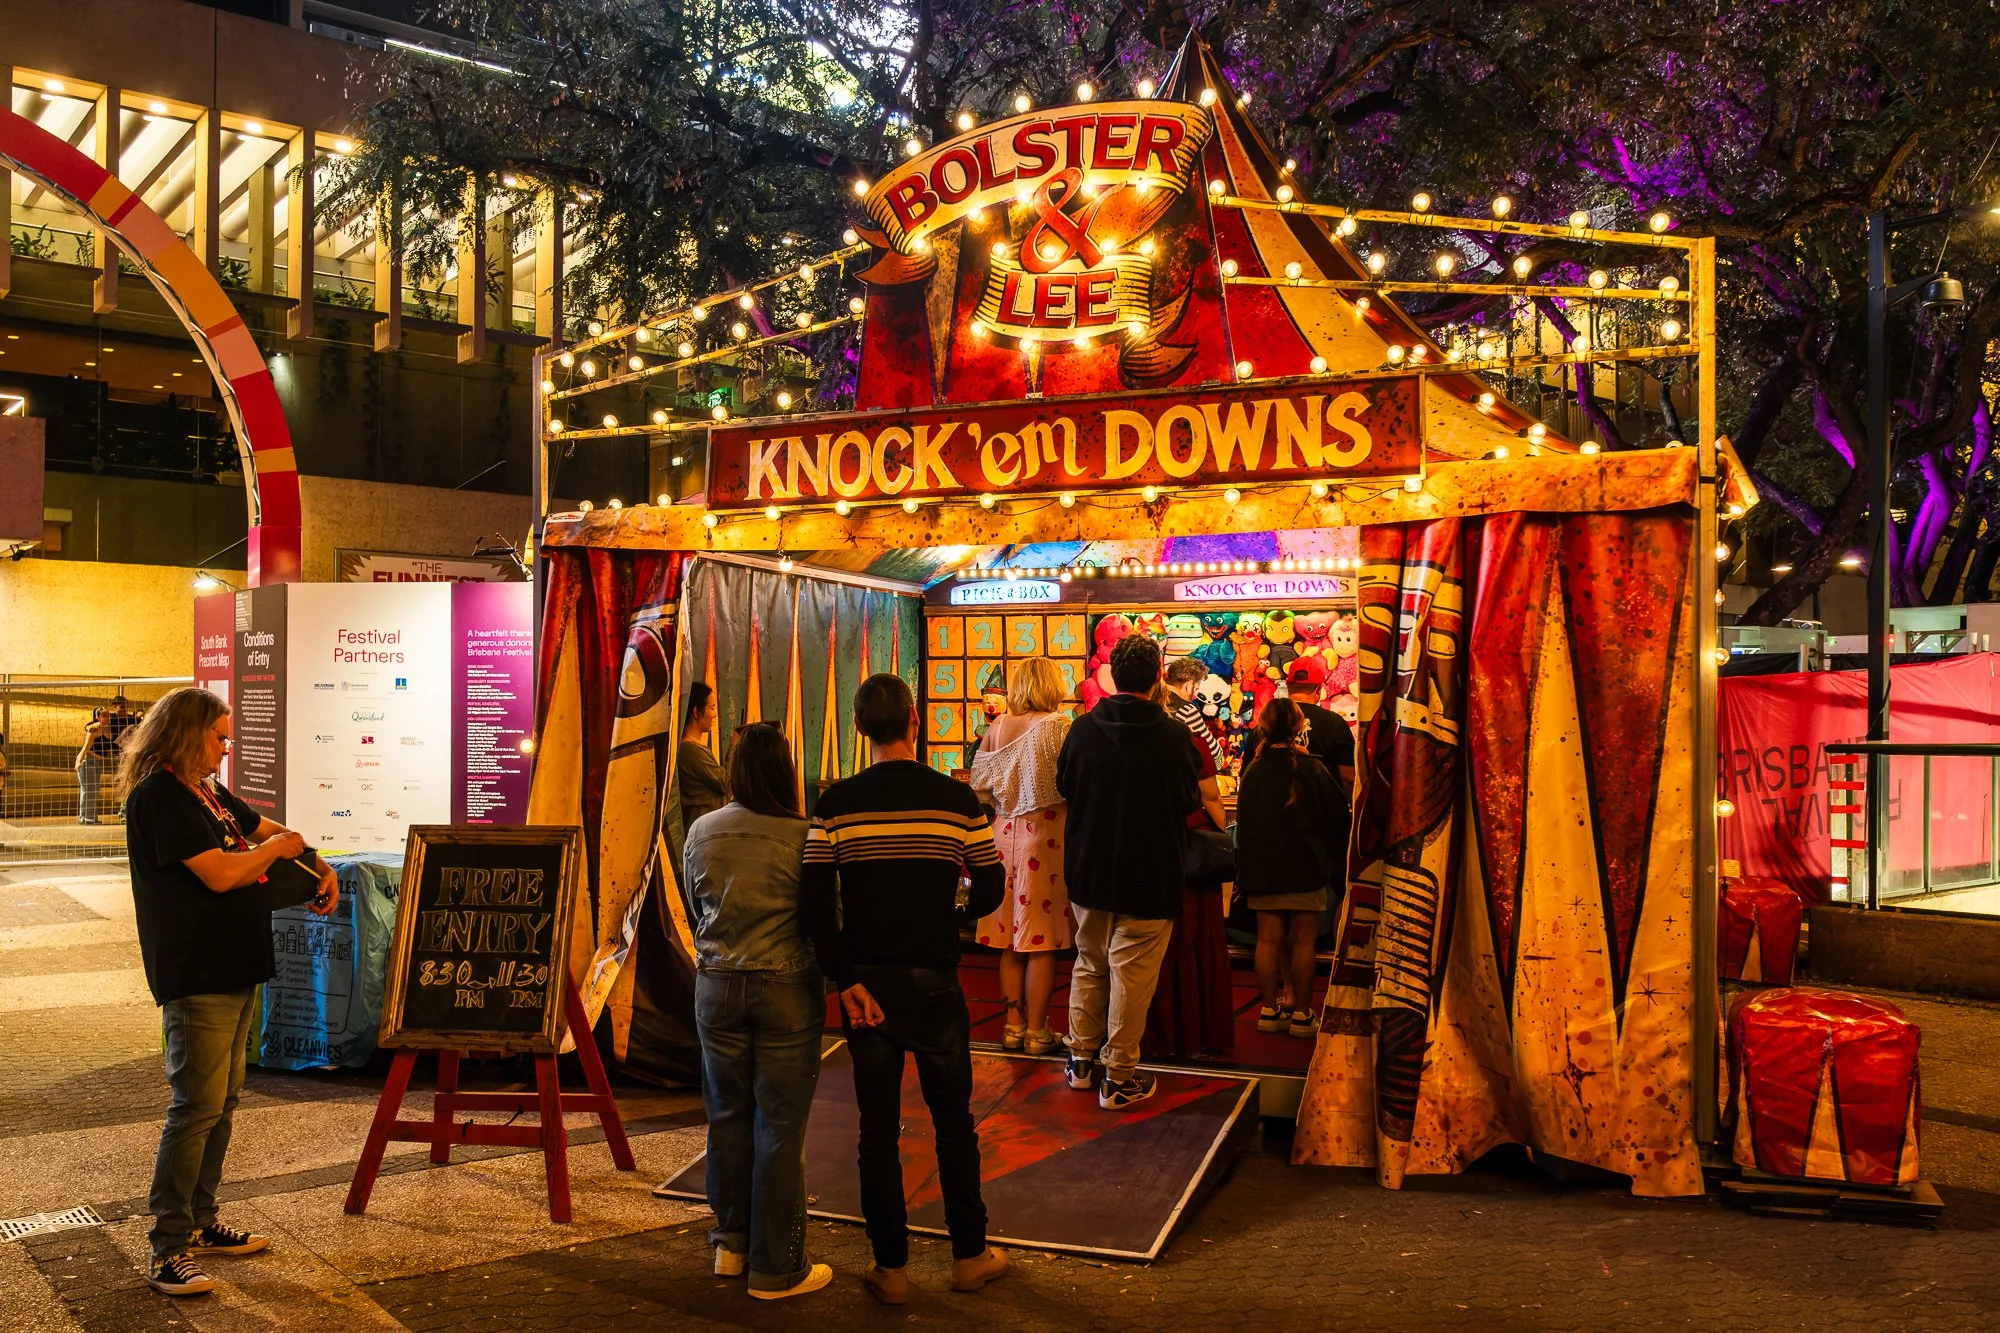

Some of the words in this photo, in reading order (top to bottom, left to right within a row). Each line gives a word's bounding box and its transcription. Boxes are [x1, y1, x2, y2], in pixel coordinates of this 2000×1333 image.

[885, 113, 1187, 234] BOLSTER
[1020, 167, 1127, 274] &
[995, 270, 1119, 329] LEE
[744, 422, 964, 501] KNOCK
[971, 416, 1087, 487] 'em
[1100, 391, 1374, 480] DOWNS
[1184, 582, 1248, 598] KNOCK
[1252, 580, 1278, 594] 'em
[1284, 579, 1351, 594] DOWNS
[200, 635, 214, 651] South
[215, 633, 228, 650] Bank
[243, 631, 275, 648] Conditions
[338, 628, 401, 645] Festival
[467, 629, 474, 637] A
[474, 629, 509, 638] heartfelt
[938, 626, 949, 650] 1
[973, 622, 995, 650] 2
[1014, 622, 1037, 653] 3
[1051, 619, 1077, 651] 4
[467, 639, 504, 648] generous
[467, 648, 501, 657] Brisbane
[198, 653, 218, 669] Precinct
[218, 652, 230, 670] Map
[247, 651, 255, 667] of
[254, 651, 271, 669] Entry
[334, 647, 405, 664] Partners
[934, 664, 956, 694] 5
[975, 662, 992, 693] 6
[935, 706, 954, 737] 9
[931, 751, 960, 777] 13
[1717, 736, 1868, 793] BRISBAE
[360, 783, 374, 791] QIC
[435, 867, 544, 907] FREE
[418, 909, 552, 955] ENTRY
[454, 989, 485, 1008] PM
[509, 989, 544, 1008] PM
